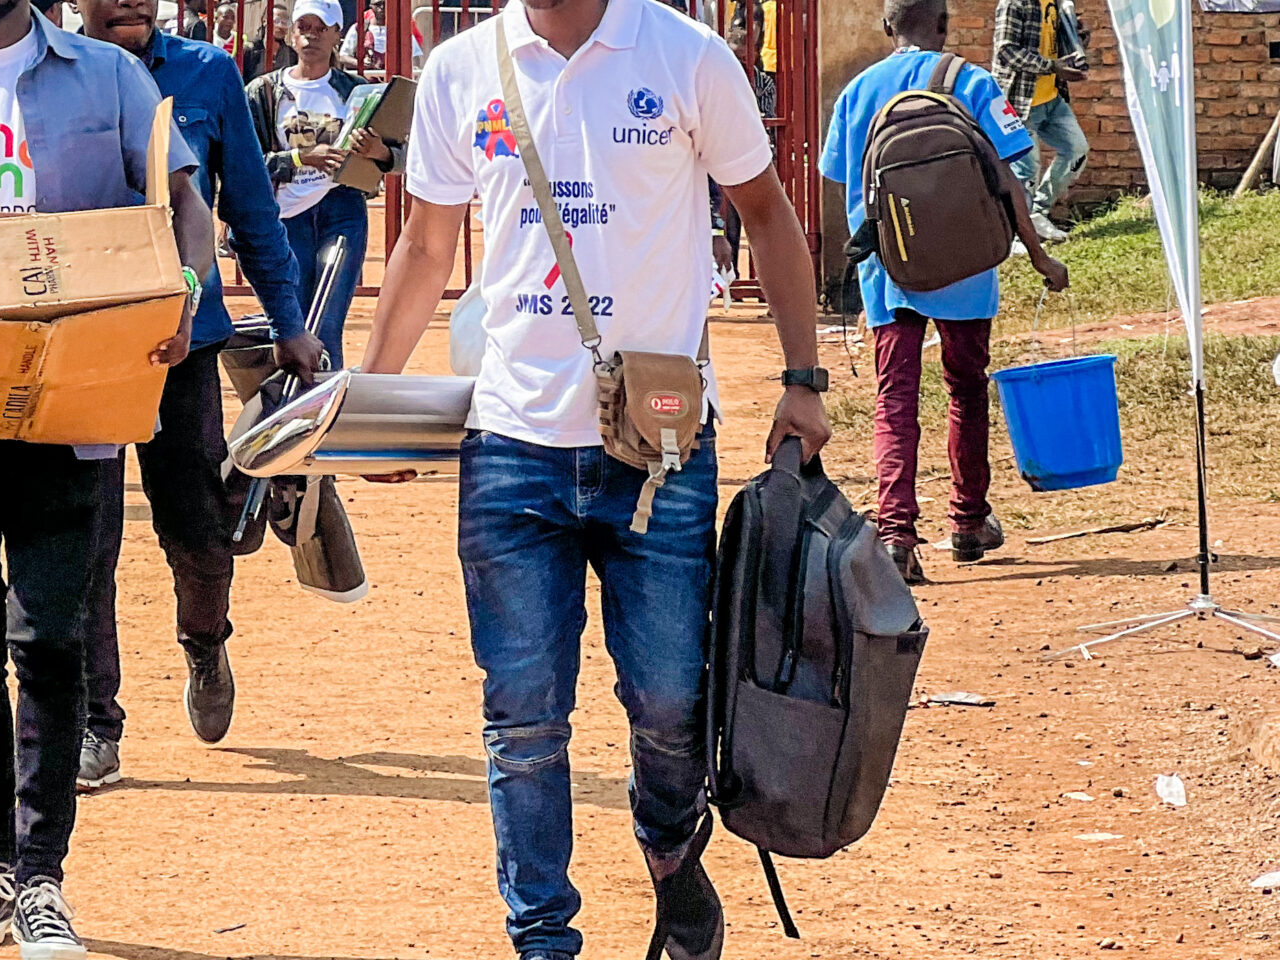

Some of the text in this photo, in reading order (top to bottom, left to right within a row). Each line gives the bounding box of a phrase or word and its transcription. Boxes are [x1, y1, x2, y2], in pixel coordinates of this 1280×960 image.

[476, 119, 511, 133] PNML
[613, 123, 677, 146] unicef
[523, 178, 594, 199] “ussons
[520, 206, 543, 229] pou
[25, 228, 42, 262] WITH
[516, 293, 614, 317] JMS 222
